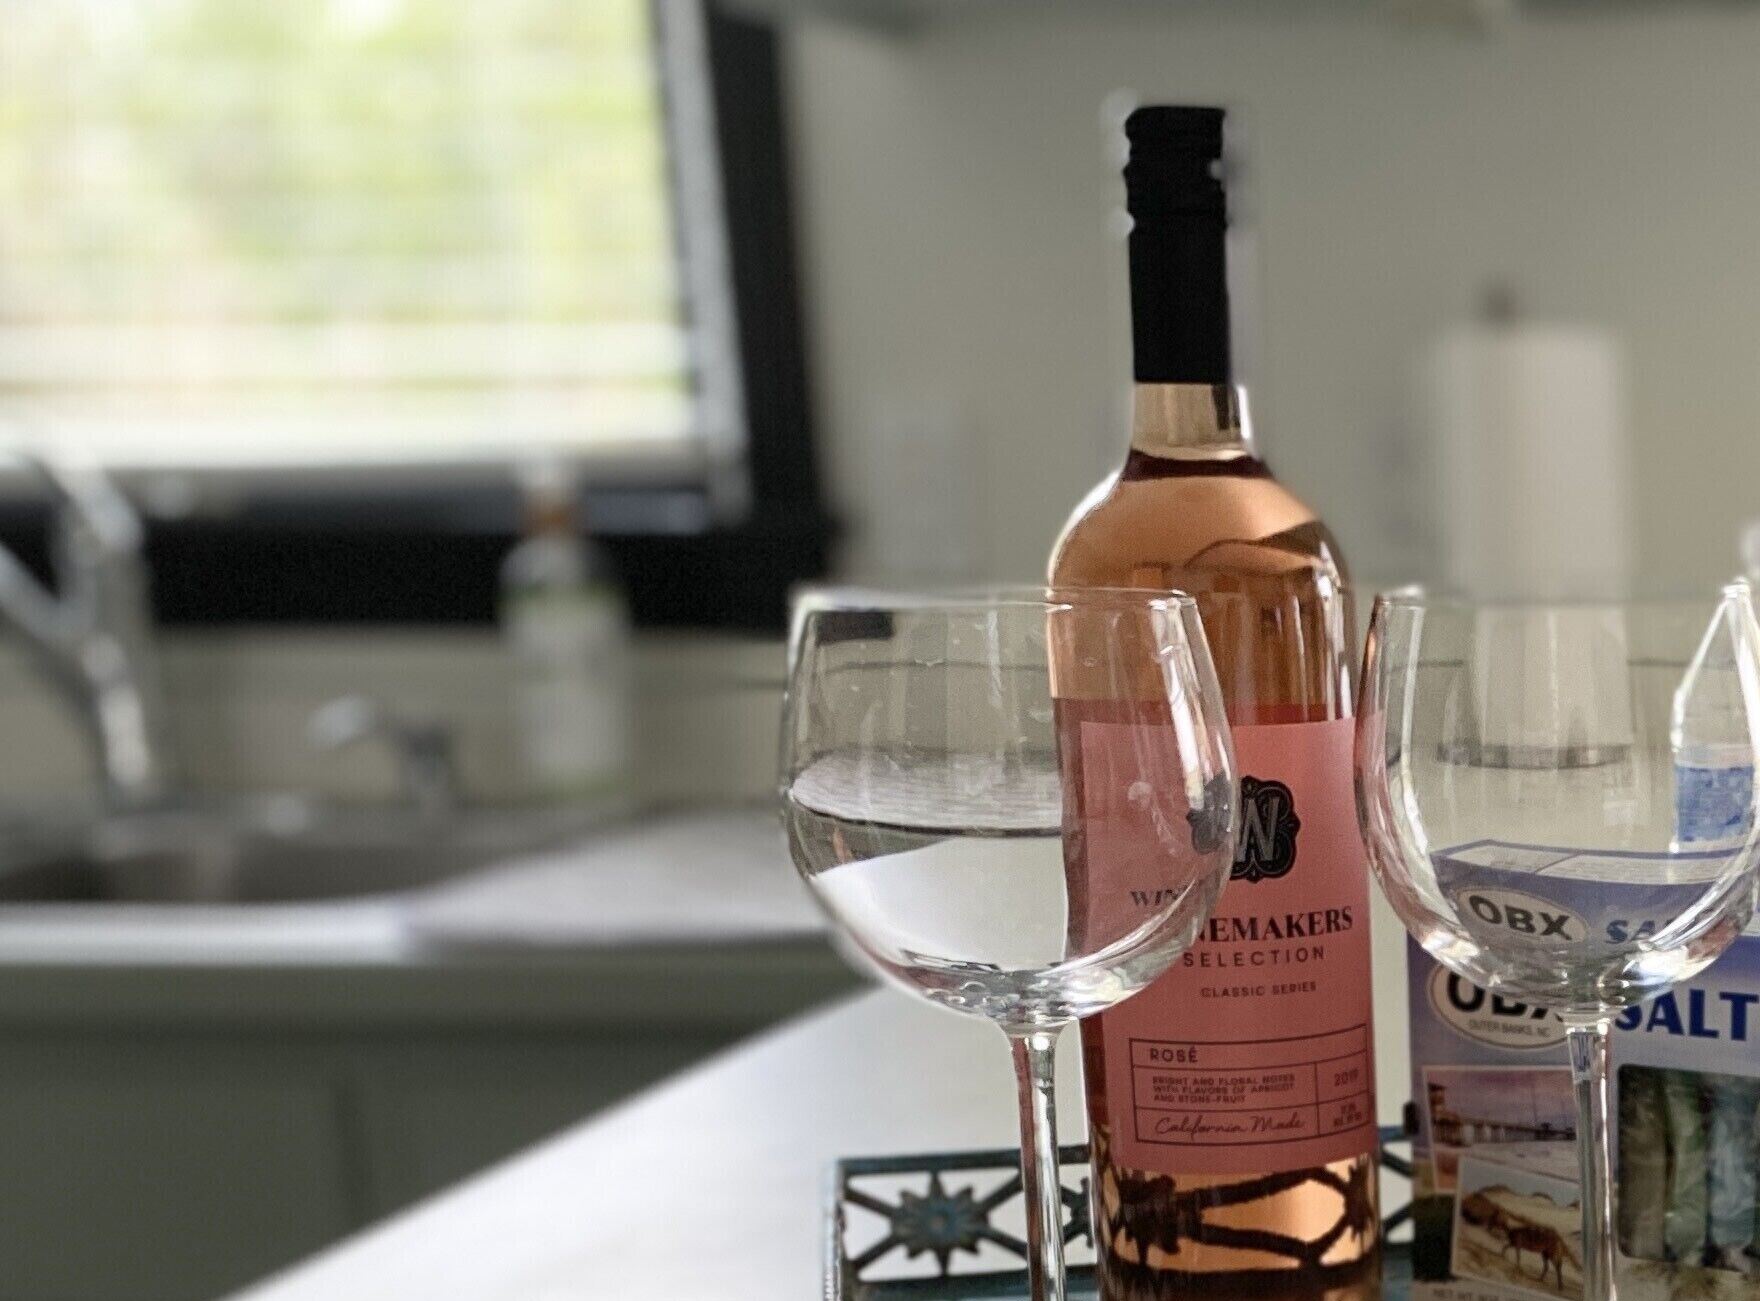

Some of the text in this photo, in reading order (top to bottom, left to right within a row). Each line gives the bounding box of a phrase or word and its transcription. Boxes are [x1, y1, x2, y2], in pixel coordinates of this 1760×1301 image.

[1468, 895, 1573, 941] OBX
[1183, 945, 1324, 968] SELECTION
[1201, 981, 1317, 998] CLASSIC SERIES
[1150, 1046, 1199, 1063] ROSÉ
[1152, 1073, 1295, 1086] BRIGHT AND FLORAL NOTES
[1153, 1083, 1295, 1095] WITH FLAVORS OF APRICOT
[1153, 1094, 1175, 1103] AND
[1154, 1115, 1249, 1141] California
[1250, 1111, 1306, 1133] Made
